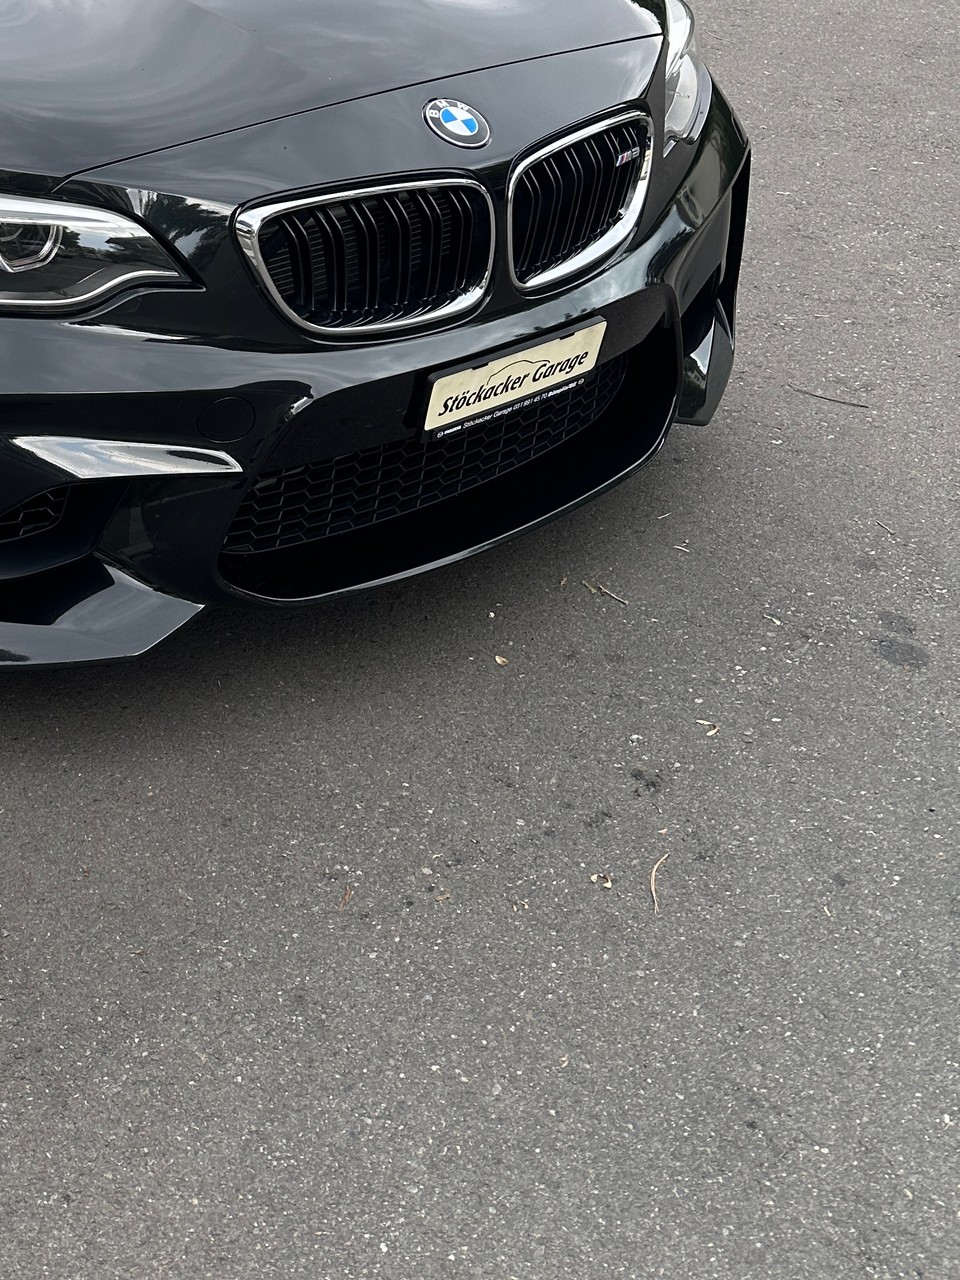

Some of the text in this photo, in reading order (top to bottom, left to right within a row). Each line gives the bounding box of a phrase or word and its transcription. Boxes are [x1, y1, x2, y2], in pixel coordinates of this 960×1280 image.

[428, 99, 470, 118] BMW
[438, 373, 530, 417] Stöckacker
[532, 351, 589, 383] Garage
